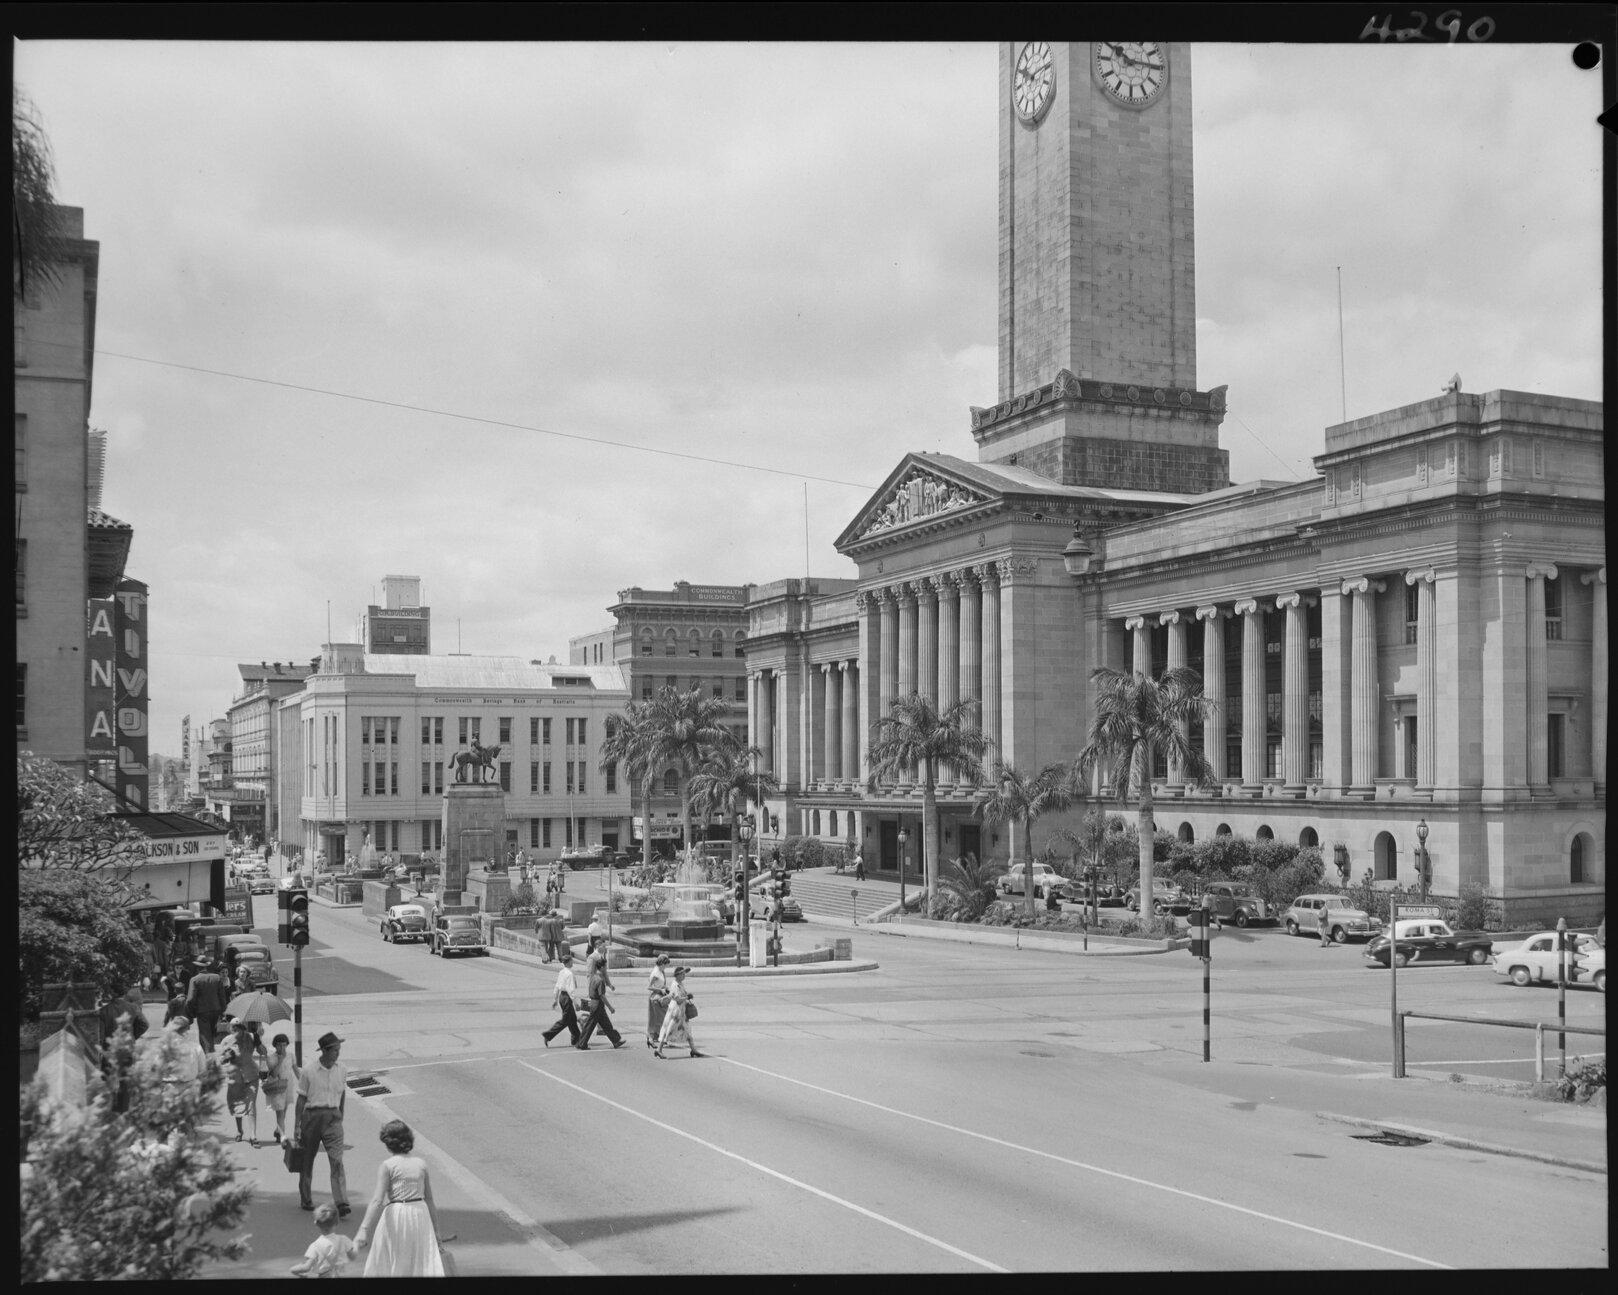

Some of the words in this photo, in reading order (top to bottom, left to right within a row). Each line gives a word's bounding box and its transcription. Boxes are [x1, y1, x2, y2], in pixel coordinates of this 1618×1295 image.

[1358, 10, 1496, 47] 4290
[90, 609, 113, 738] ANA
[116, 591, 148, 813] TIVOLI
[137, 843, 173, 857] ACKSON
[176, 844, 181, 855] &
[183, 841, 199, 855] SON
